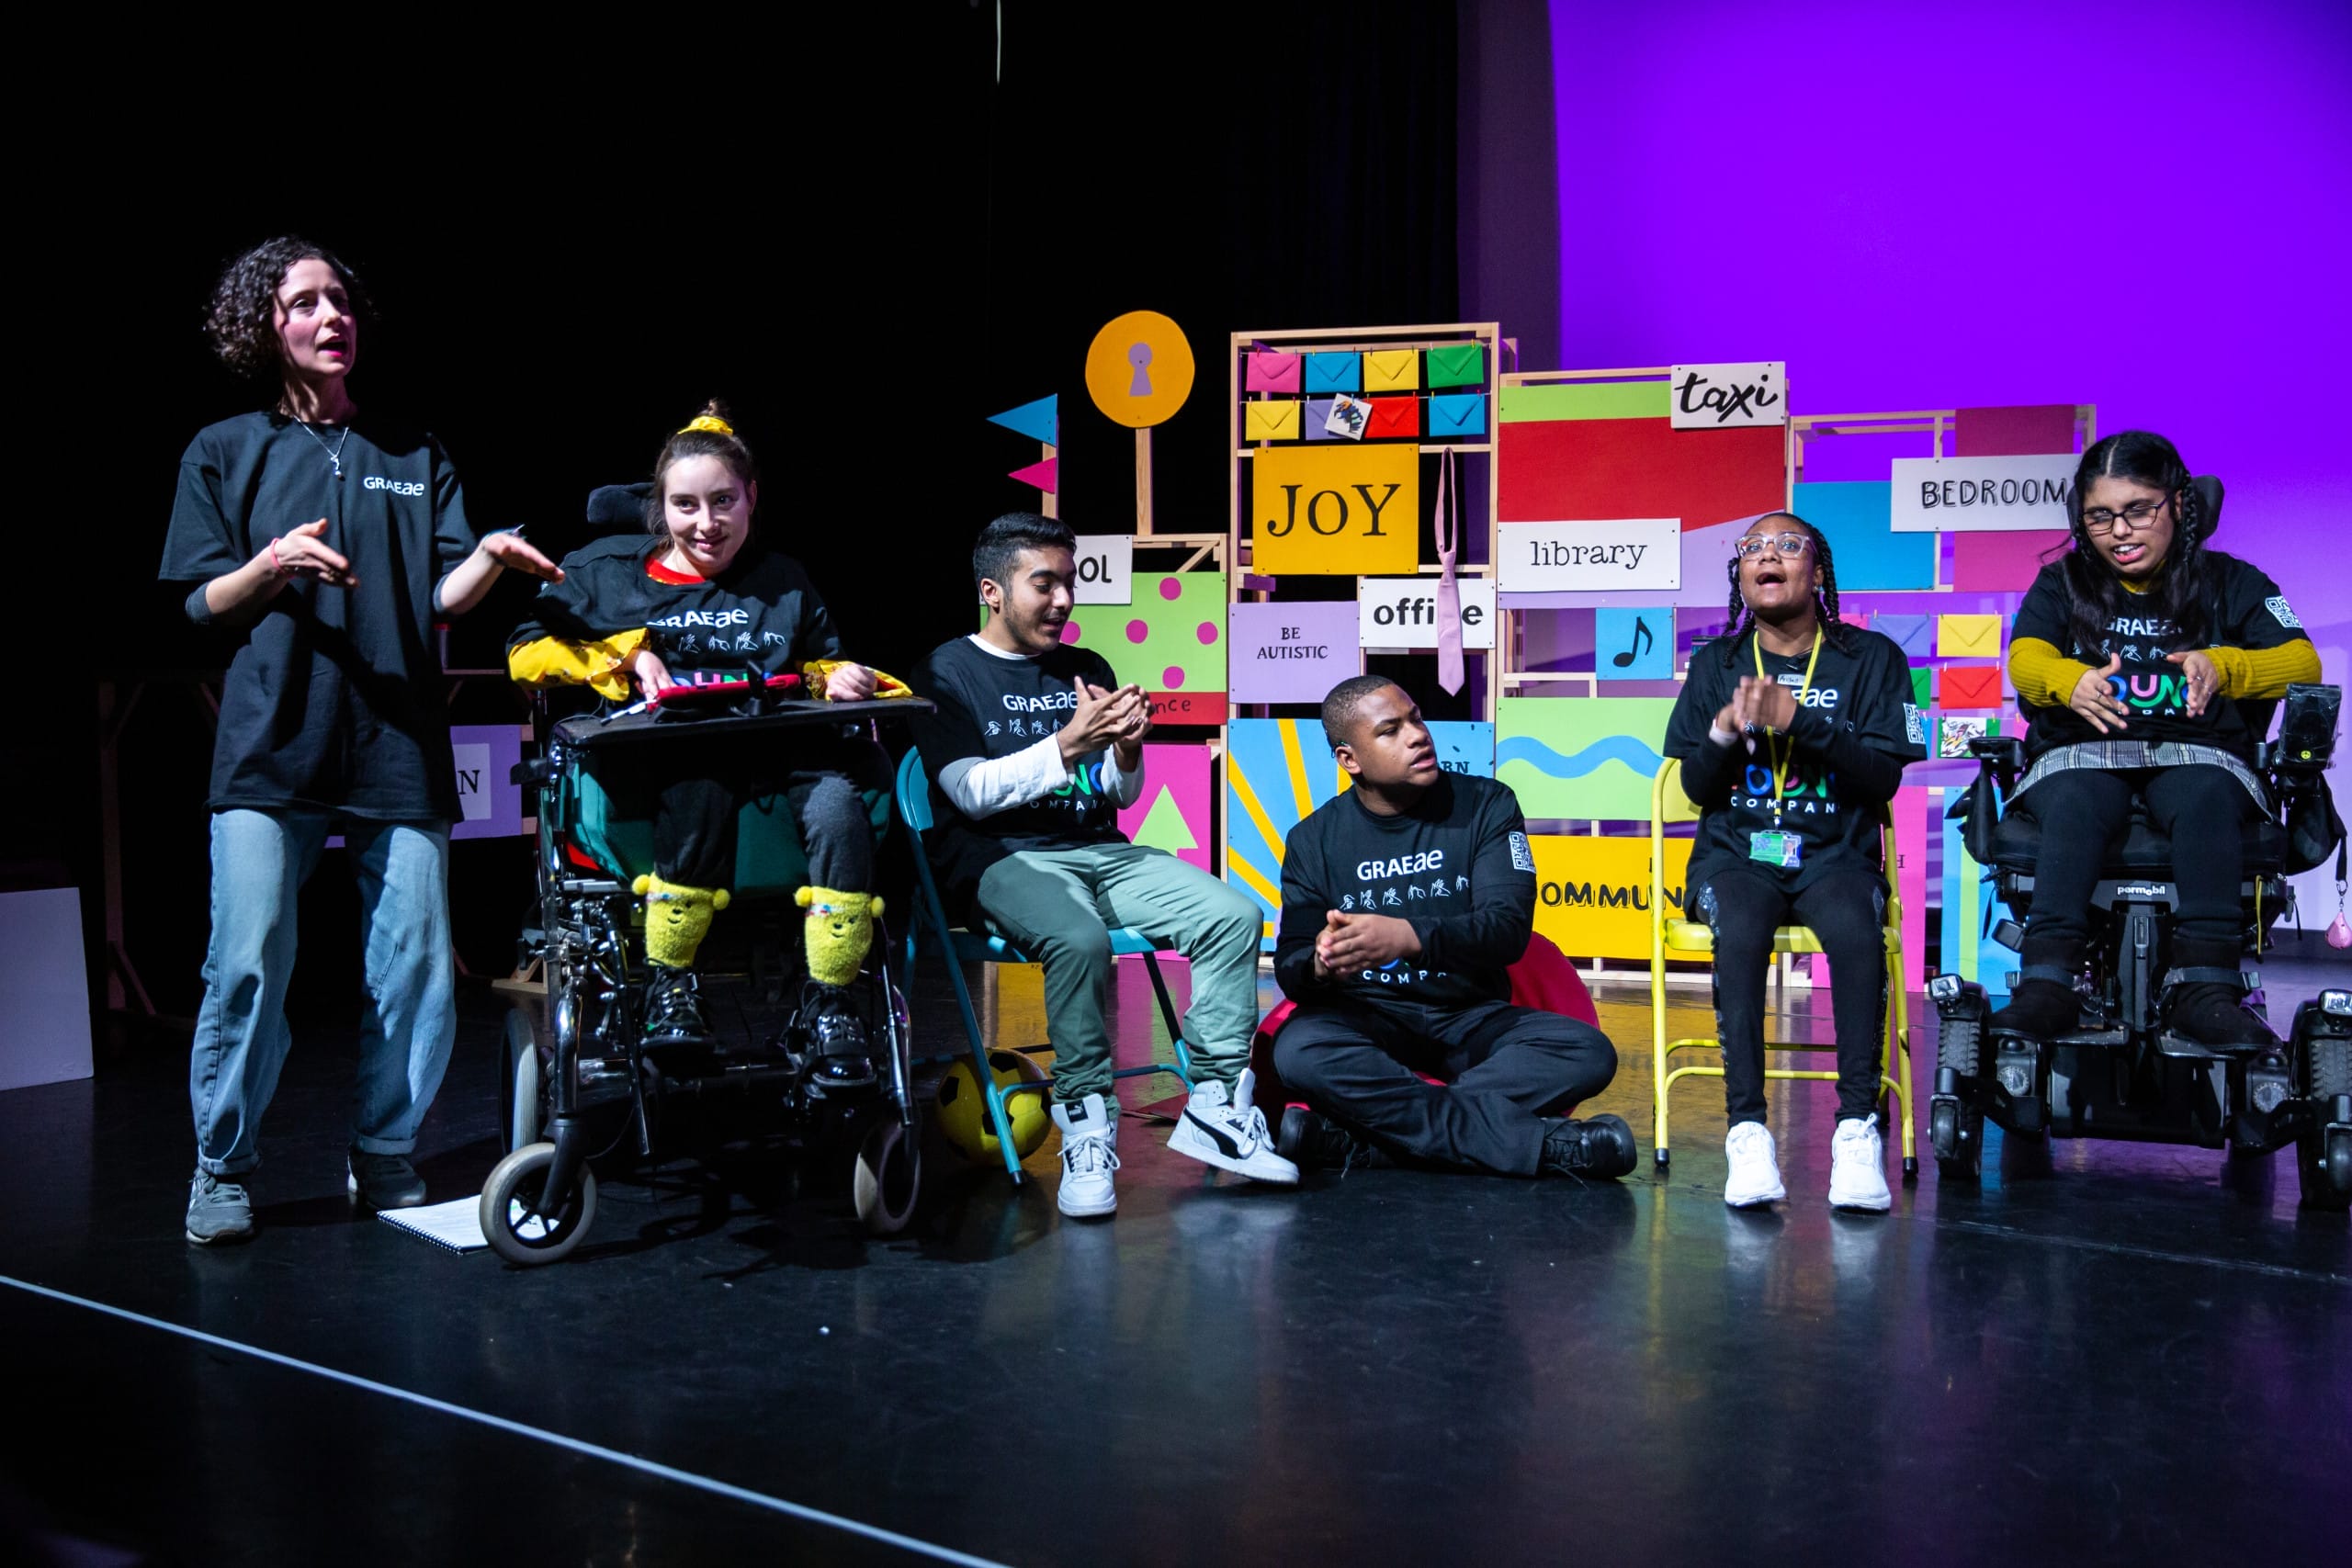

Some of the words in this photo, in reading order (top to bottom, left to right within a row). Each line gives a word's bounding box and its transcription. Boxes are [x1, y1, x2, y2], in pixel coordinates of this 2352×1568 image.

[1675, 372, 1778, 423] taxi
[364, 477, 424, 496] GRAEae
[1922, 479, 2067, 508] BEDROOM
[1267, 484, 1402, 537] JOY
[1530, 540, 1647, 570] library
[1078, 554, 1113, 583] OL
[1374, 598, 1483, 626] offie
[1281, 626, 1301, 640] BE
[1257, 645, 1329, 660] AUTISTIC
[1154, 699, 1191, 714] nce
[1440, 760, 1470, 774] RN
[1730, 795, 1836, 813] COMPAN
[1356, 849, 1443, 881] GRAEae
[1541, 882, 1685, 912] OMMUN
[2117, 885, 2165, 896] permobil
[1362, 969, 1447, 984] COMP
